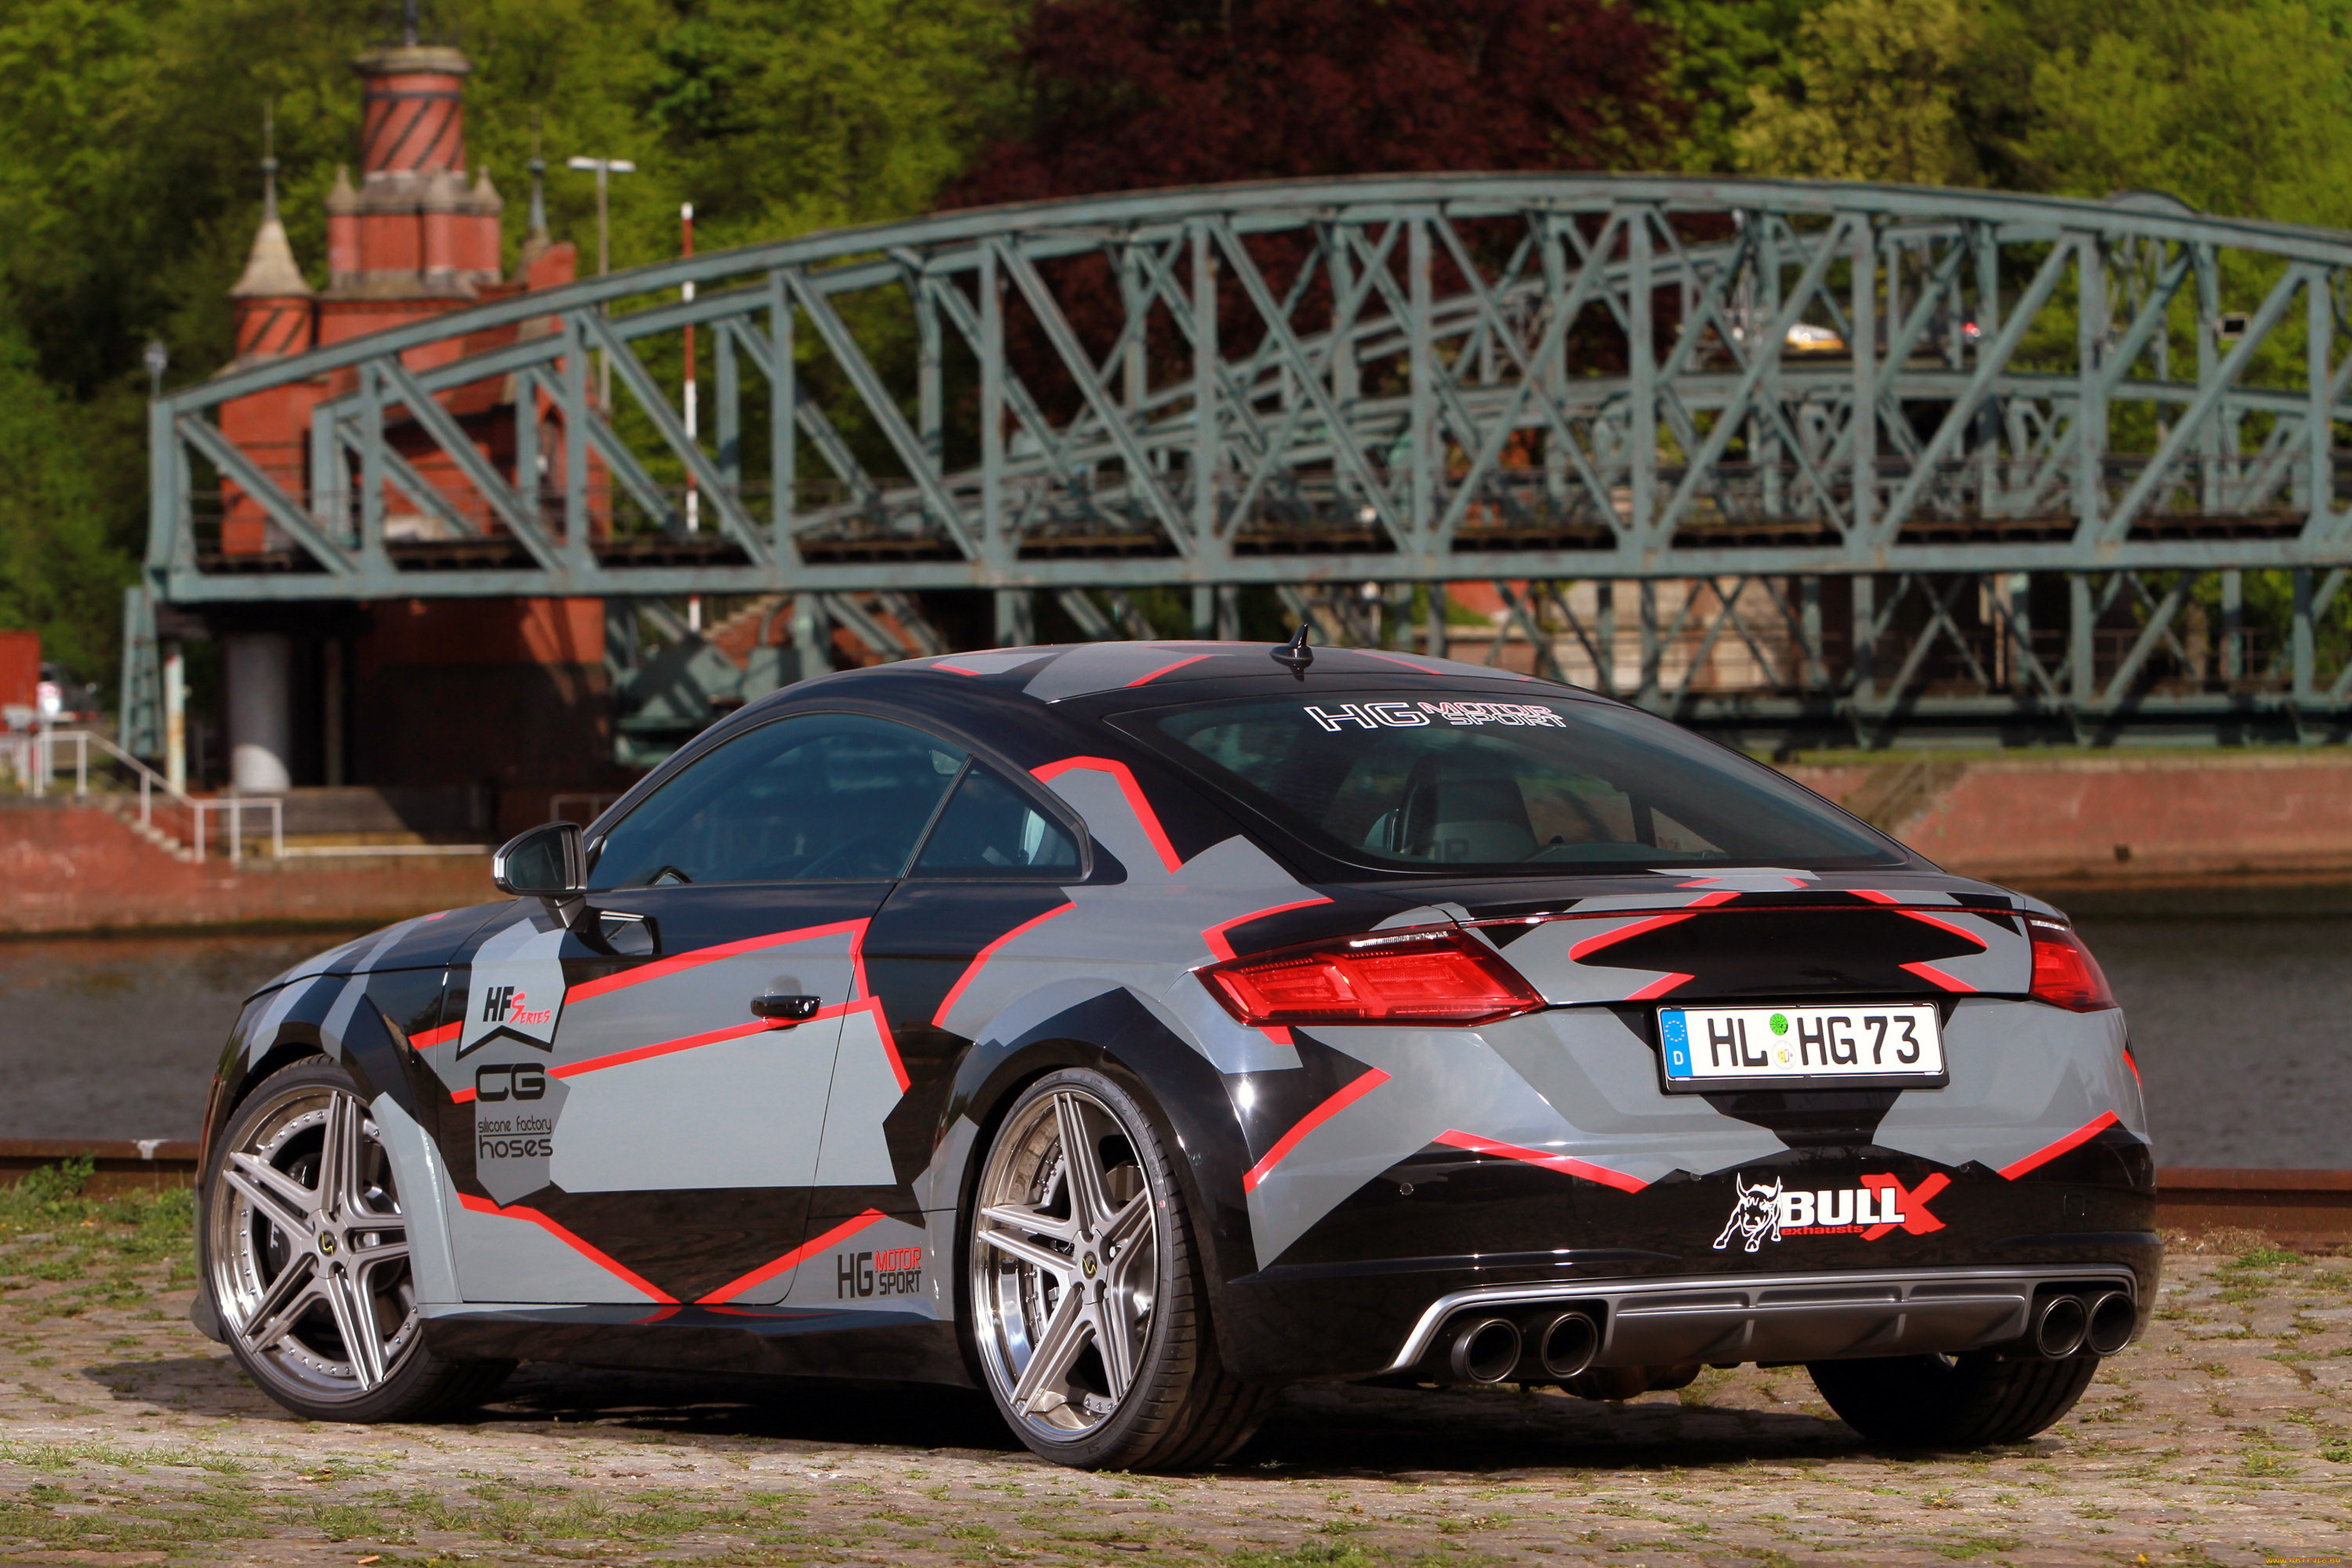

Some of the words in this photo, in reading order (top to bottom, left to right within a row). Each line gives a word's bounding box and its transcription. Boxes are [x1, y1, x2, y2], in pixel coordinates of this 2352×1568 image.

[1303, 702, 1431, 732] HG
[1417, 702, 1553, 717] MOTOR
[1442, 713, 1566, 727] SPORT
[1673, 1050, 1684, 1065] D
[1708, 1017, 1768, 1067] HL
[475, 1062, 546, 1102] CG
[478, 1117, 511, 1133] silicone
[516, 1115, 552, 1135] factory
[479, 1135, 553, 1159] hoses
[1781, 1224, 1864, 1236] exhausts
[838, 1252, 873, 1299] HG
[875, 1247, 921, 1272] MOTOR
[879, 1270, 922, 1295] SPORT
